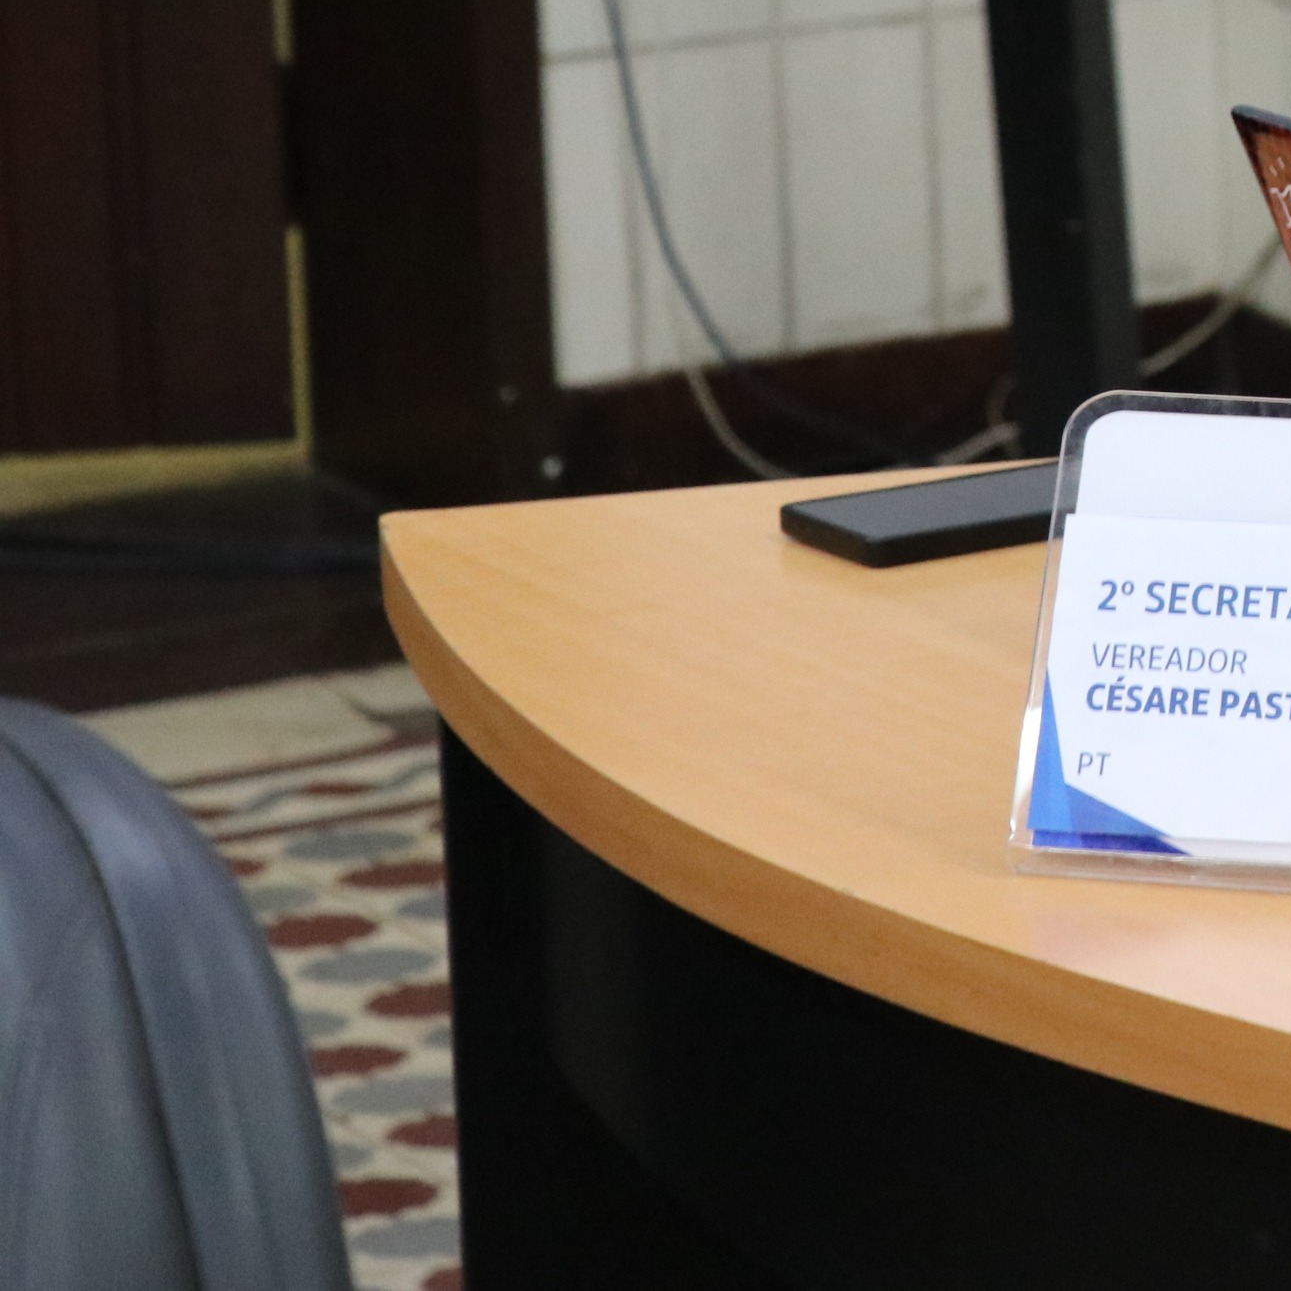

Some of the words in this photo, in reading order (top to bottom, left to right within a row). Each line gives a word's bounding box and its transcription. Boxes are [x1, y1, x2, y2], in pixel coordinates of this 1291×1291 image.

[1092, 642, 1248, 675] VEREADOR
[1086, 676, 1211, 716] CÉSARE
[1076, 751, 1111, 777] PT
